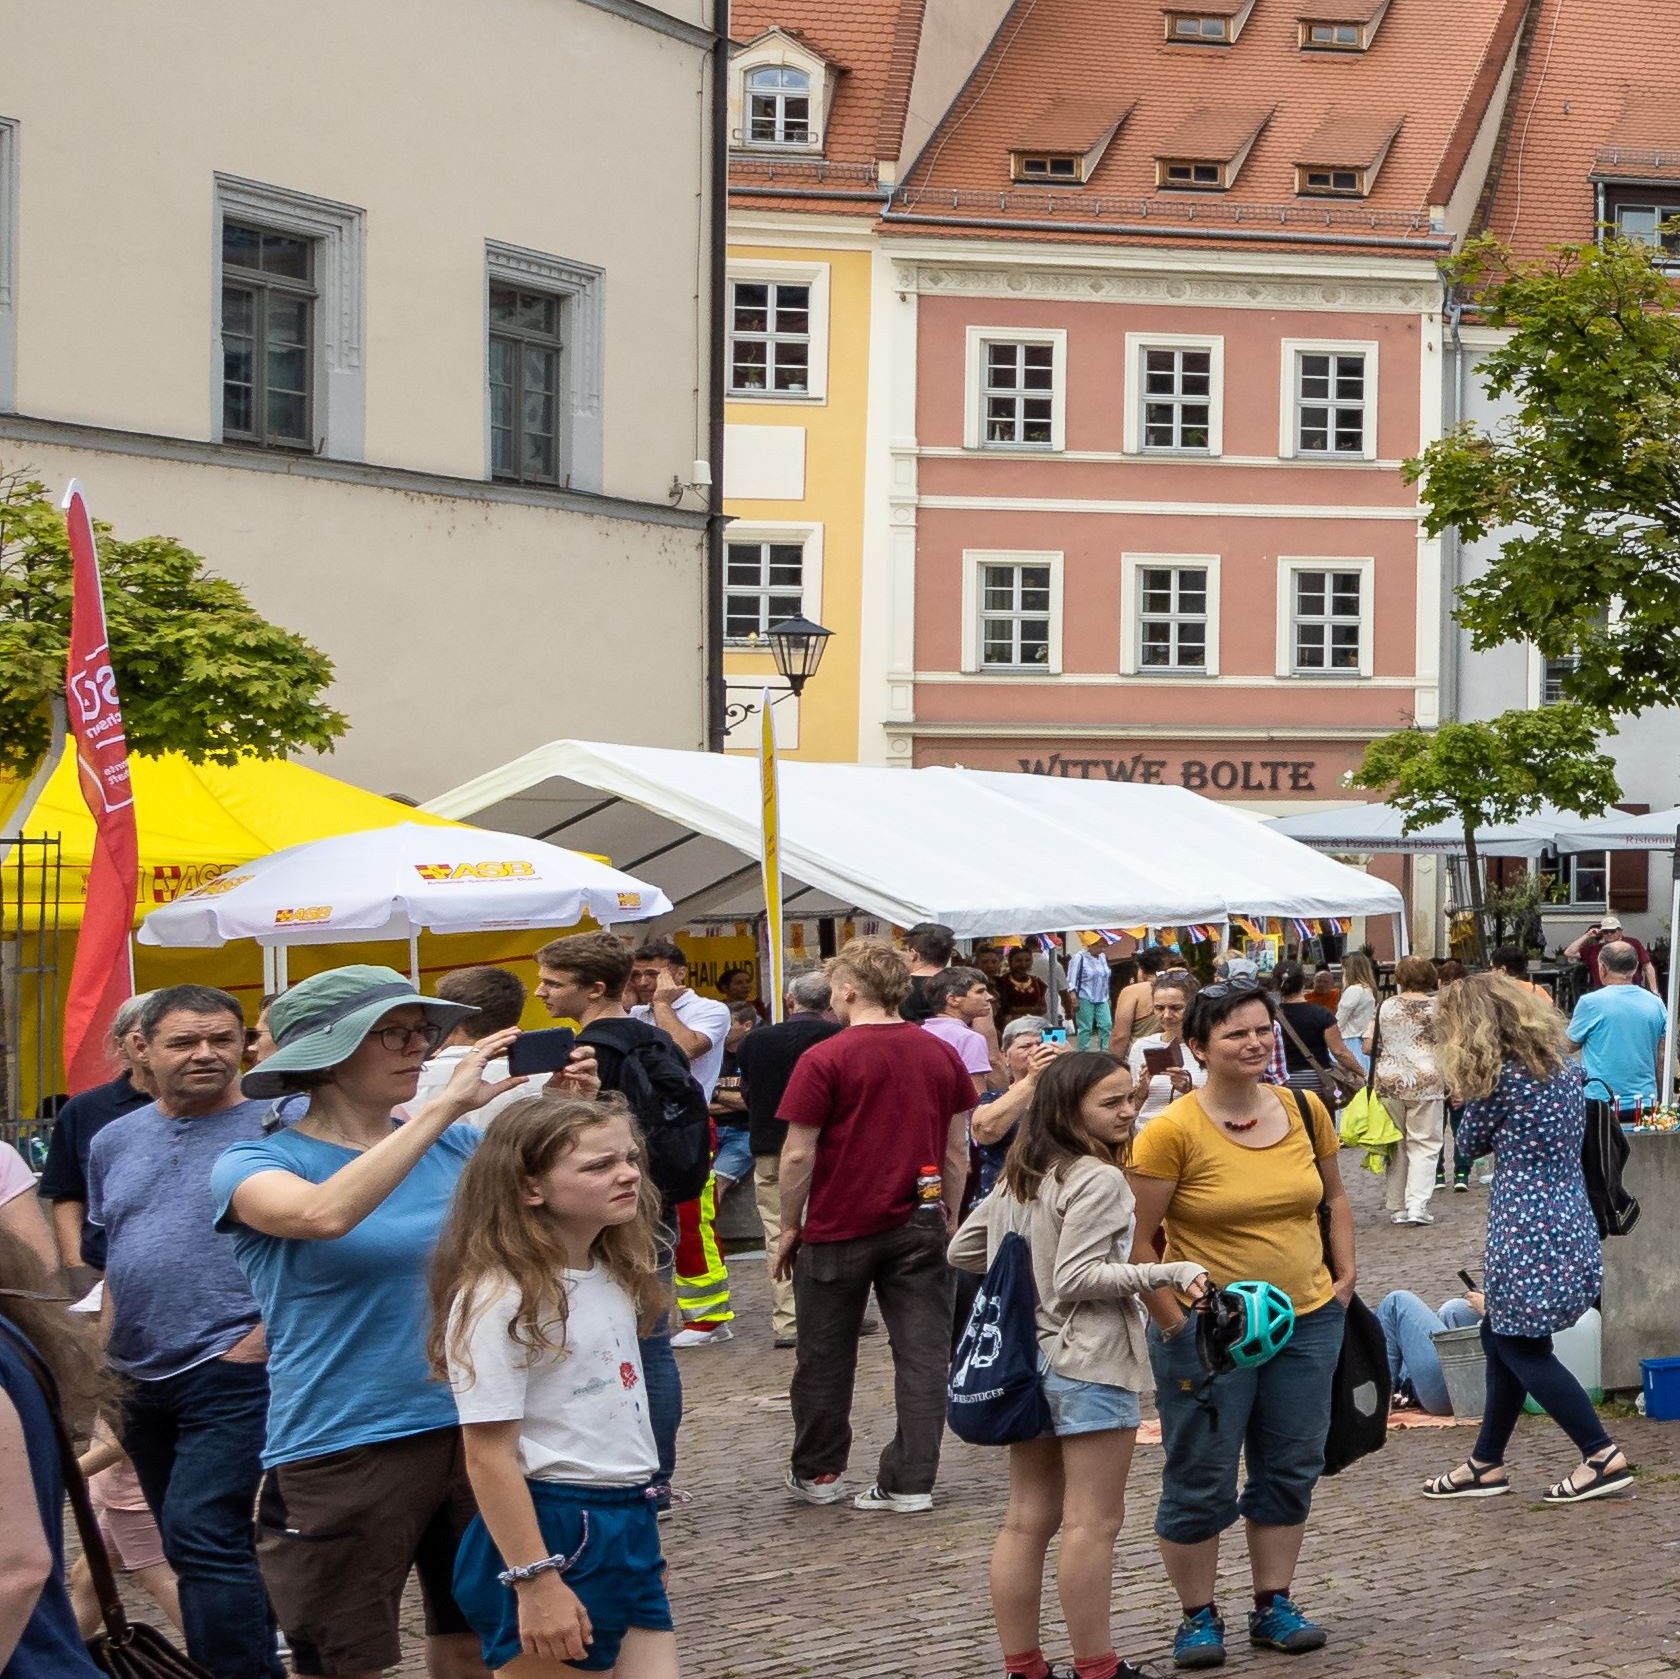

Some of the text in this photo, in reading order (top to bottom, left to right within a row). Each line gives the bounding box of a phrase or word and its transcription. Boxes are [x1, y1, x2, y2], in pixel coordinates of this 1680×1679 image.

[1180, 759, 1317, 791] BOLTE
[1345, 838, 1393, 848] Pizzeria
[1414, 839, 1448, 849] Dolce
[1625, 835, 1677, 845] Ristorant
[451, 861, 535, 879] ASB
